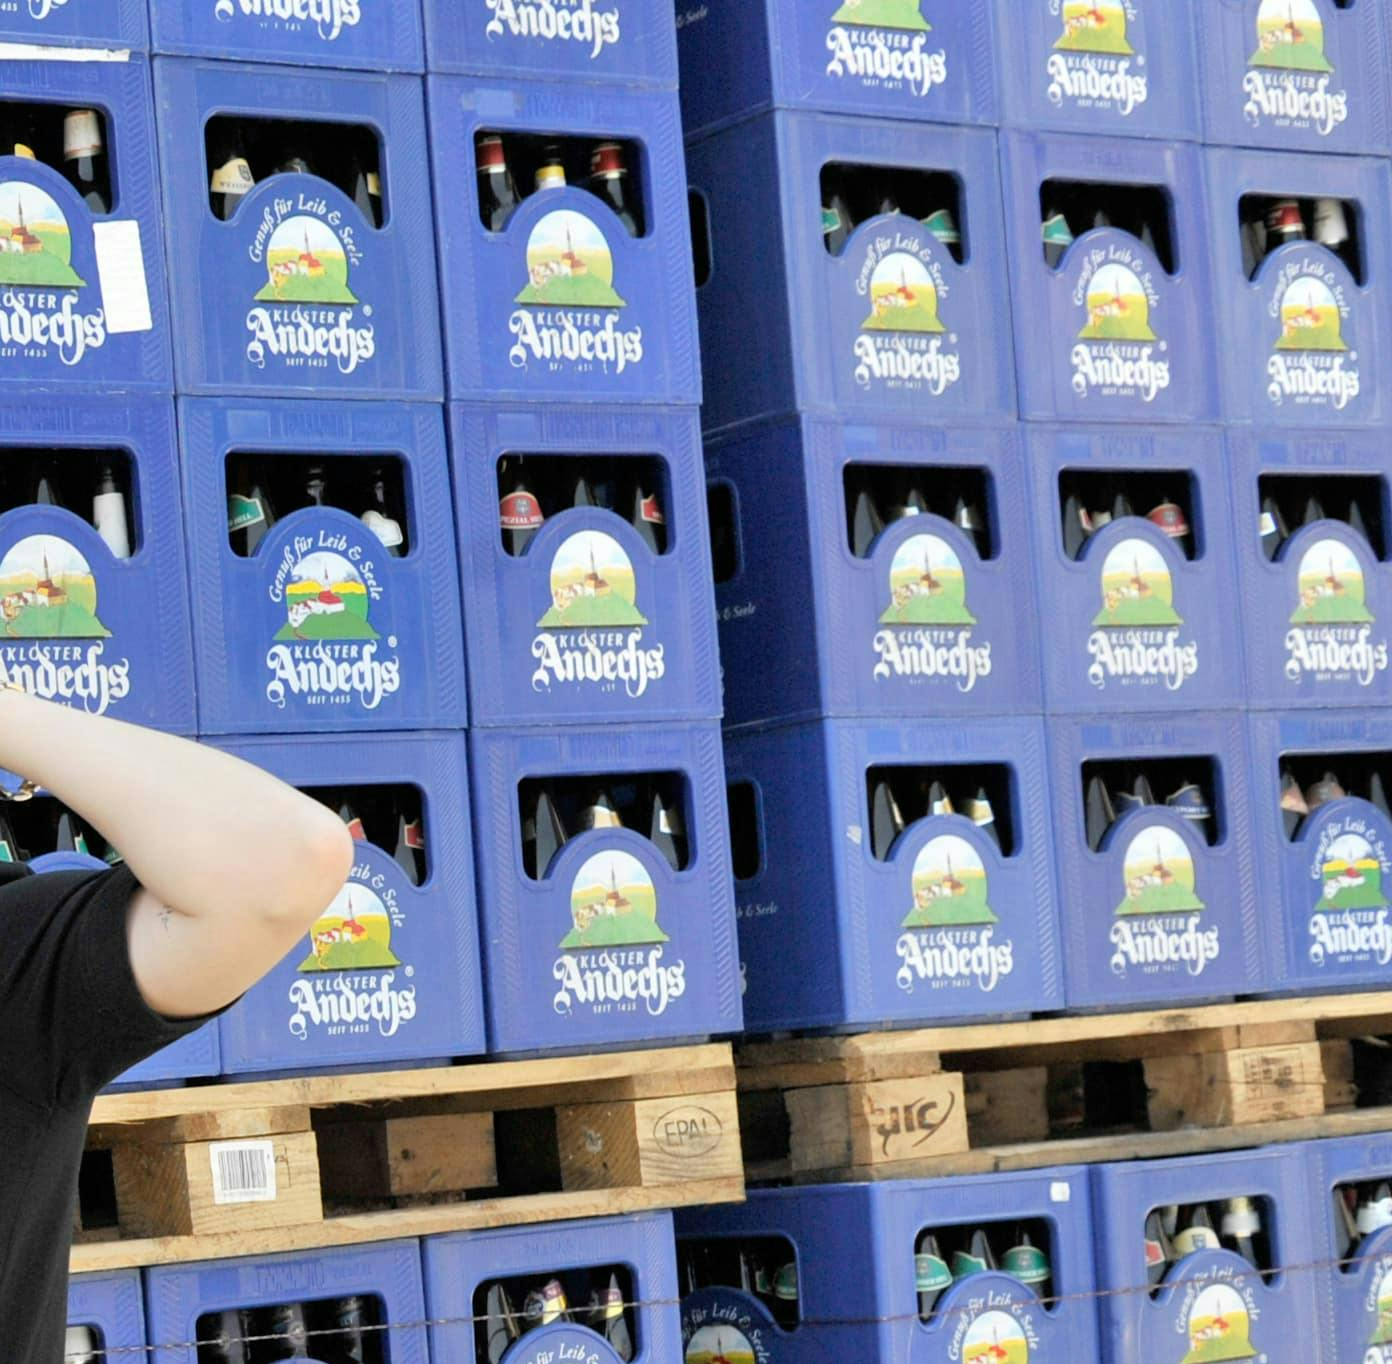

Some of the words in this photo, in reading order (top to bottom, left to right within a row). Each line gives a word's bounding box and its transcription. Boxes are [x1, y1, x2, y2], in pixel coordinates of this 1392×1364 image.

[274, 310, 334, 323] KLOSTER
[537, 312, 600, 326] KLOSTER
[247, 304, 374, 373] Andechs
[509, 306, 641, 378] Andechs
[560, 633, 623, 647] KLOSTER
[9, 648, 83, 661] KLOSTER
[295, 645, 358, 659] KLOSTER
[532, 627, 663, 698] Andechs
[266, 639, 399, 708] Andechs
[581, 951, 644, 968] KLOSTER
[316, 976, 376, 992] KLOSTER
[553, 945, 684, 1019] Andechs
[289, 970, 415, 1040] Andechs
